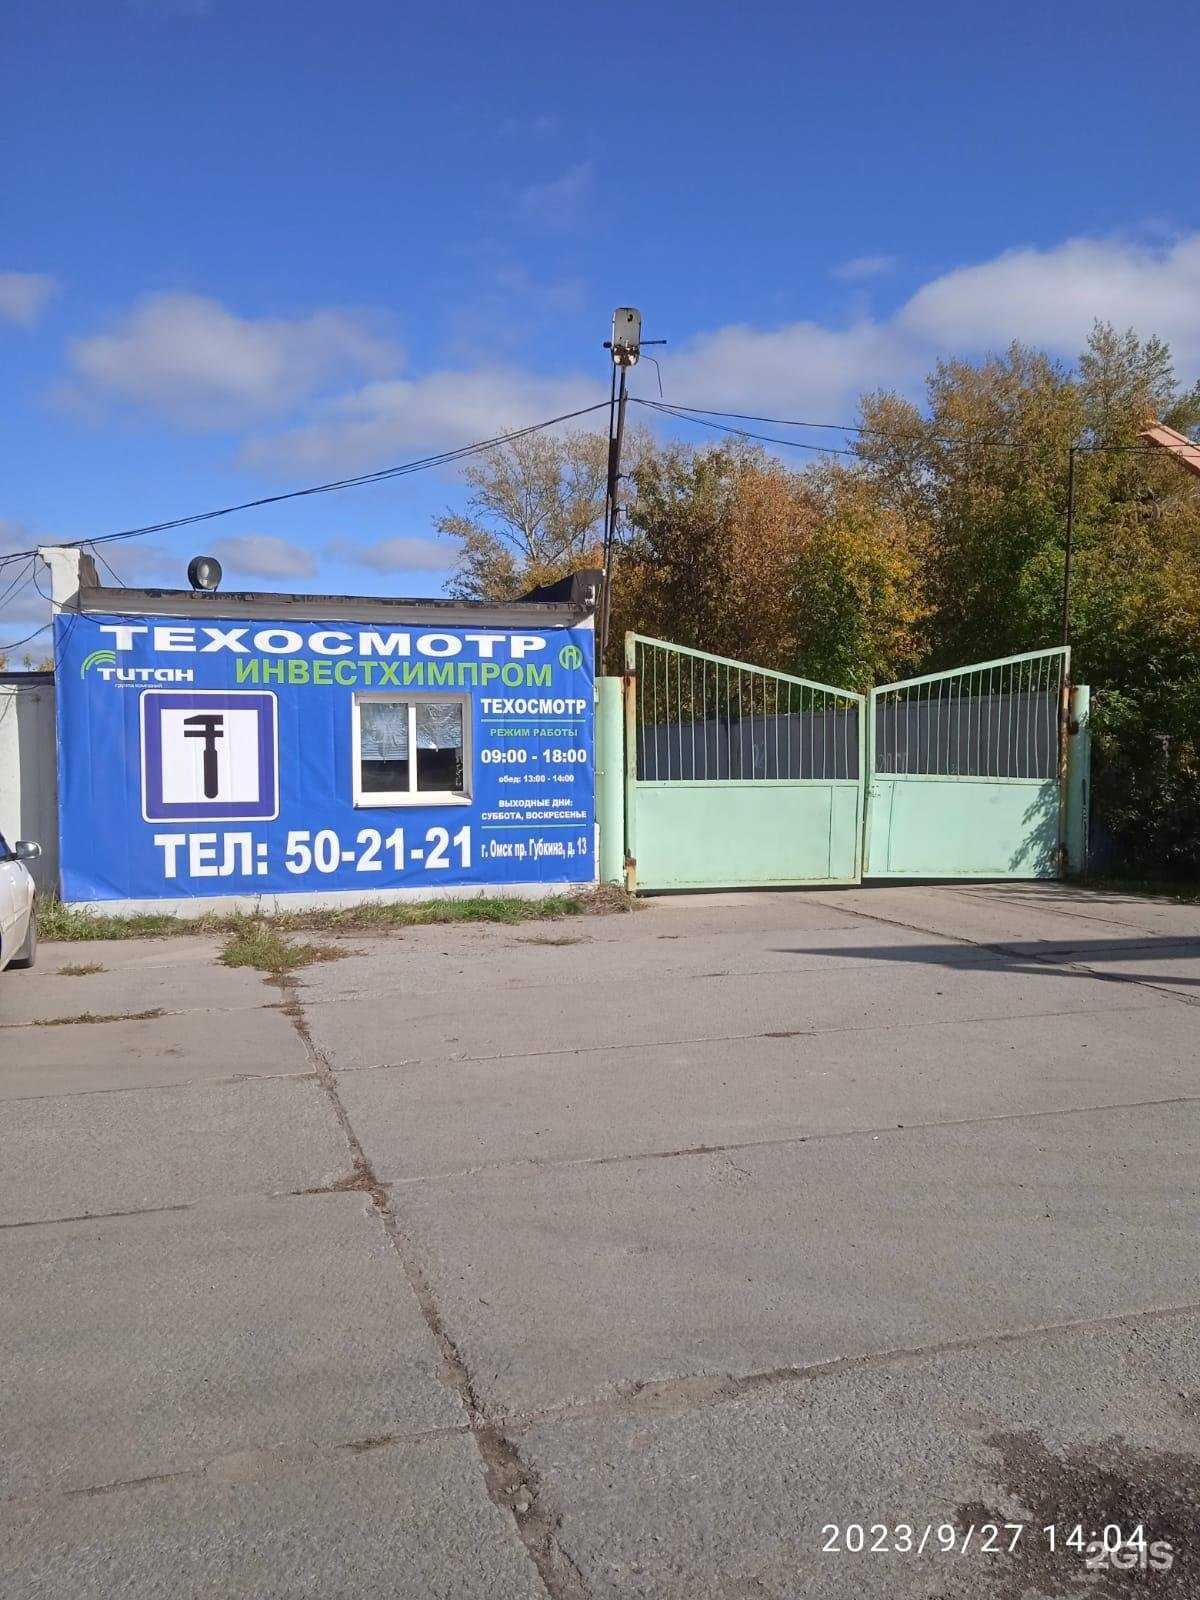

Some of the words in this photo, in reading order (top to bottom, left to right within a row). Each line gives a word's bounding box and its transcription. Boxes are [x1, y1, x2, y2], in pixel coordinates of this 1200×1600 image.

[99, 625, 547, 659] ТЕХОСМОТР
[235, 658, 552, 687] ИНВЕСТХИМПРОМ
[480, 698, 587, 715] ТЕХОСМОТР
[490, 728, 530, 737] РЕЖИМ
[533, 728, 578, 737] РАБОТЫ
[481, 749, 527, 764] 09:00
[543, 749, 587, 763] 18:00
[498, 775, 521, 783] обед:
[523, 774, 546, 783] 13:00
[498, 799, 550, 808] ВЫХОДНЫЕ
[552, 798, 574, 808] ДНИ:
[481, 812, 524, 821] СУББОТА,
[526, 811, 587, 819] ВОСКРЕСЕНЬЕ
[154, 832, 268, 878] ТЕЛ:
[284, 825, 471, 875] 50-21-21
[481, 844, 489, 858] г.
[490, 840, 513, 858] Омск
[514, 843, 527, 861] пр.
[529, 838, 566, 861] Губкина,
[567, 841, 575, 858] д.
[577, 837, 587, 855] 13
